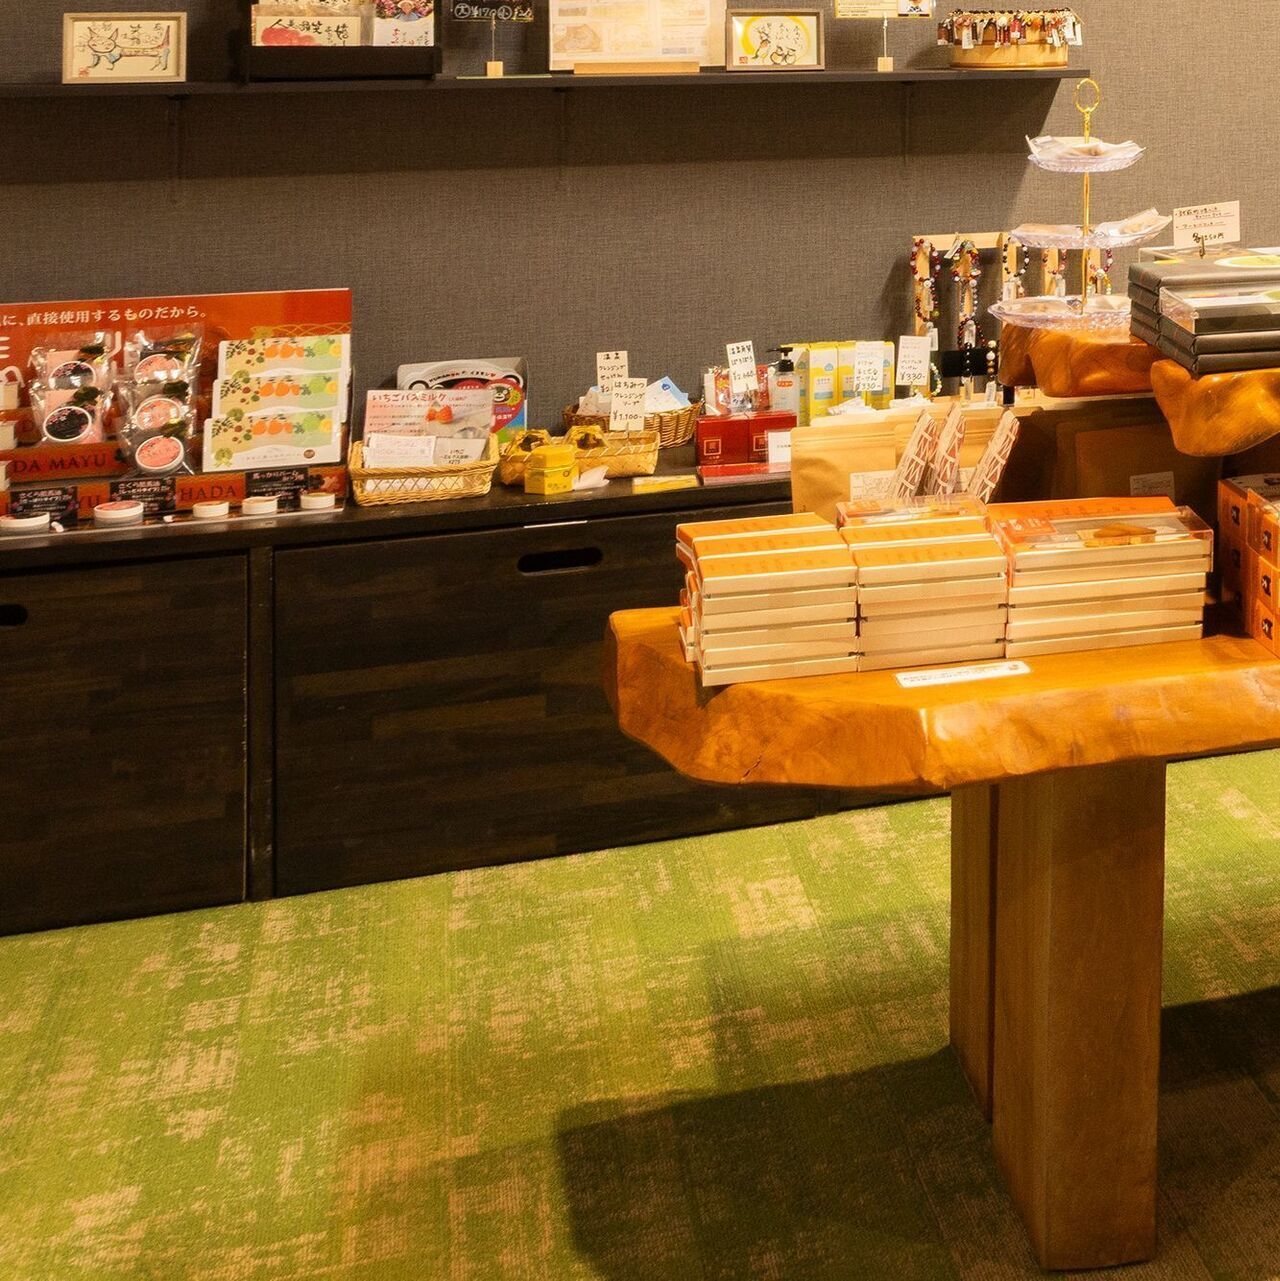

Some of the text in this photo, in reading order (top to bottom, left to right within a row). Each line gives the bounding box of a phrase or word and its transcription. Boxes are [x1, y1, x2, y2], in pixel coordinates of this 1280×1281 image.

[0, 305, 207, 327] に、直接使用するものだから。
